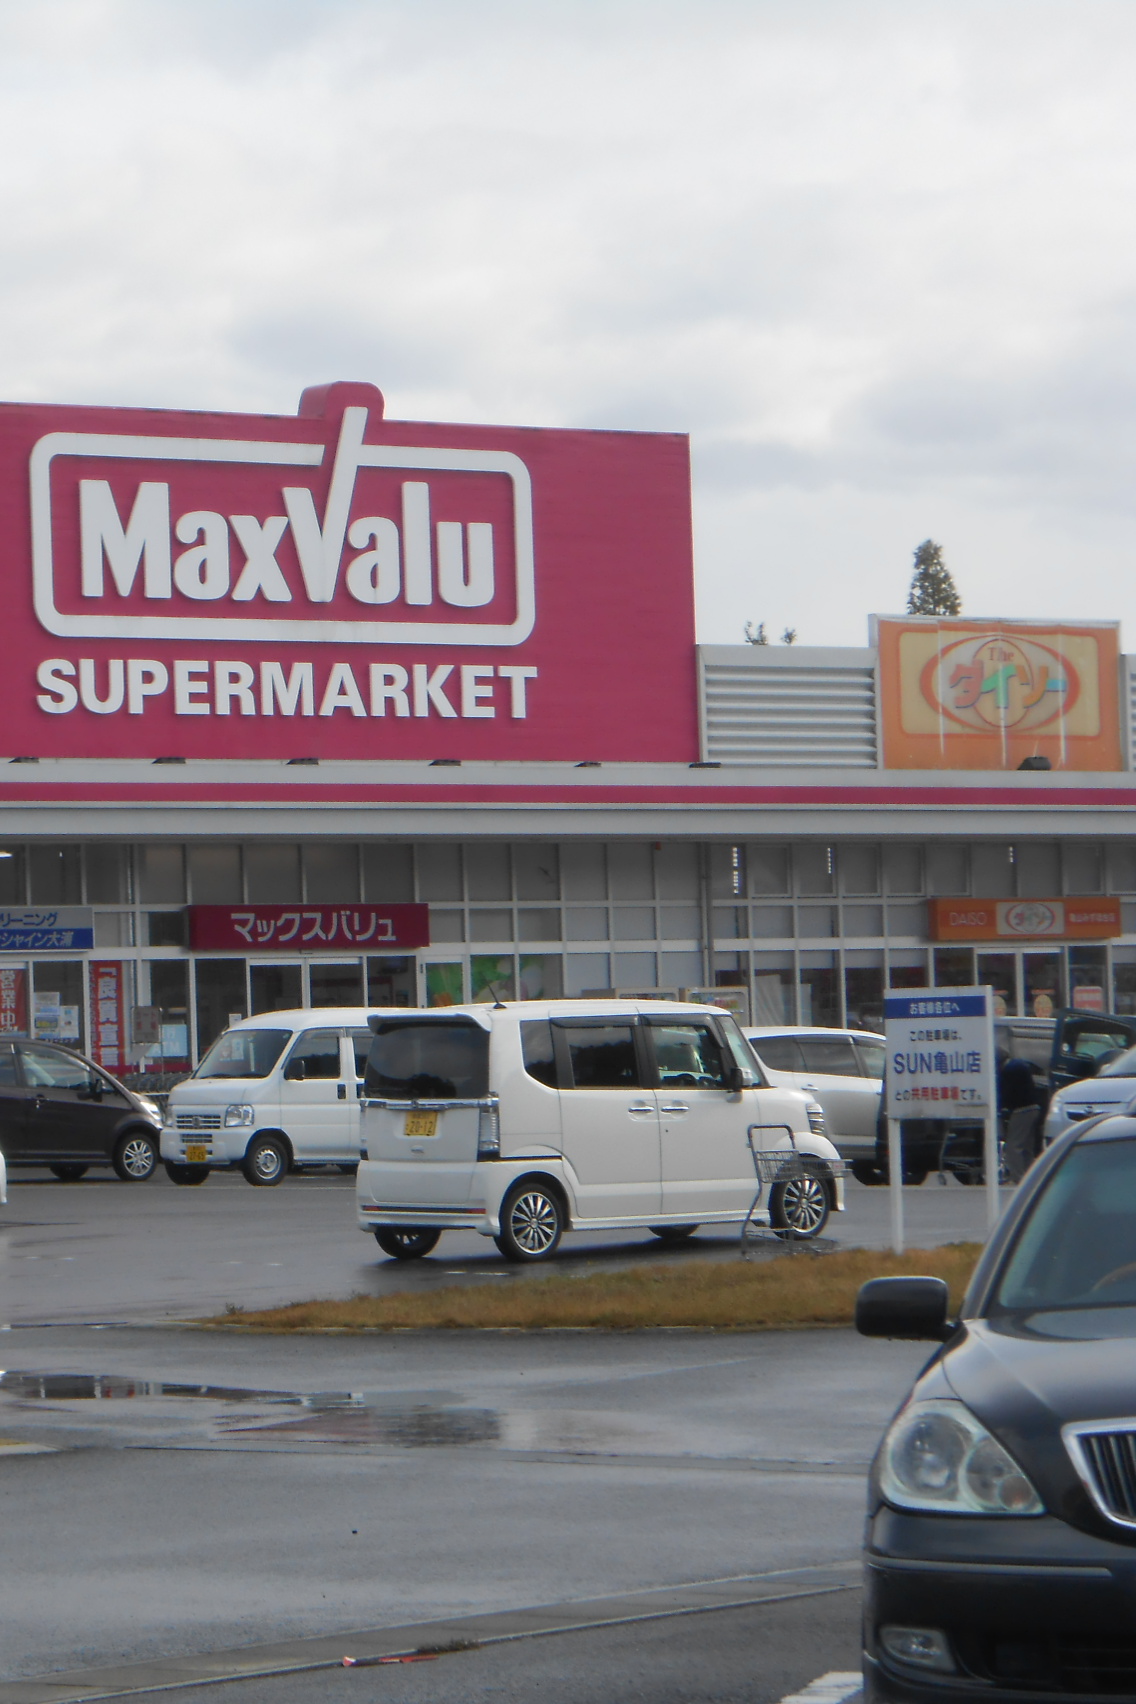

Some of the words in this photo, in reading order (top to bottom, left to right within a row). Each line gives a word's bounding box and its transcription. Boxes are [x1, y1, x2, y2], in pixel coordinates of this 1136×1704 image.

[79, 406, 495, 607] MaxValu
[36, 658, 538, 719] SUPERMARKET
[230, 911, 397, 941] マックスバリュ
[949, 912, 987, 926] DAISO
[893, 1051, 981, 1075] SUN亀山店
